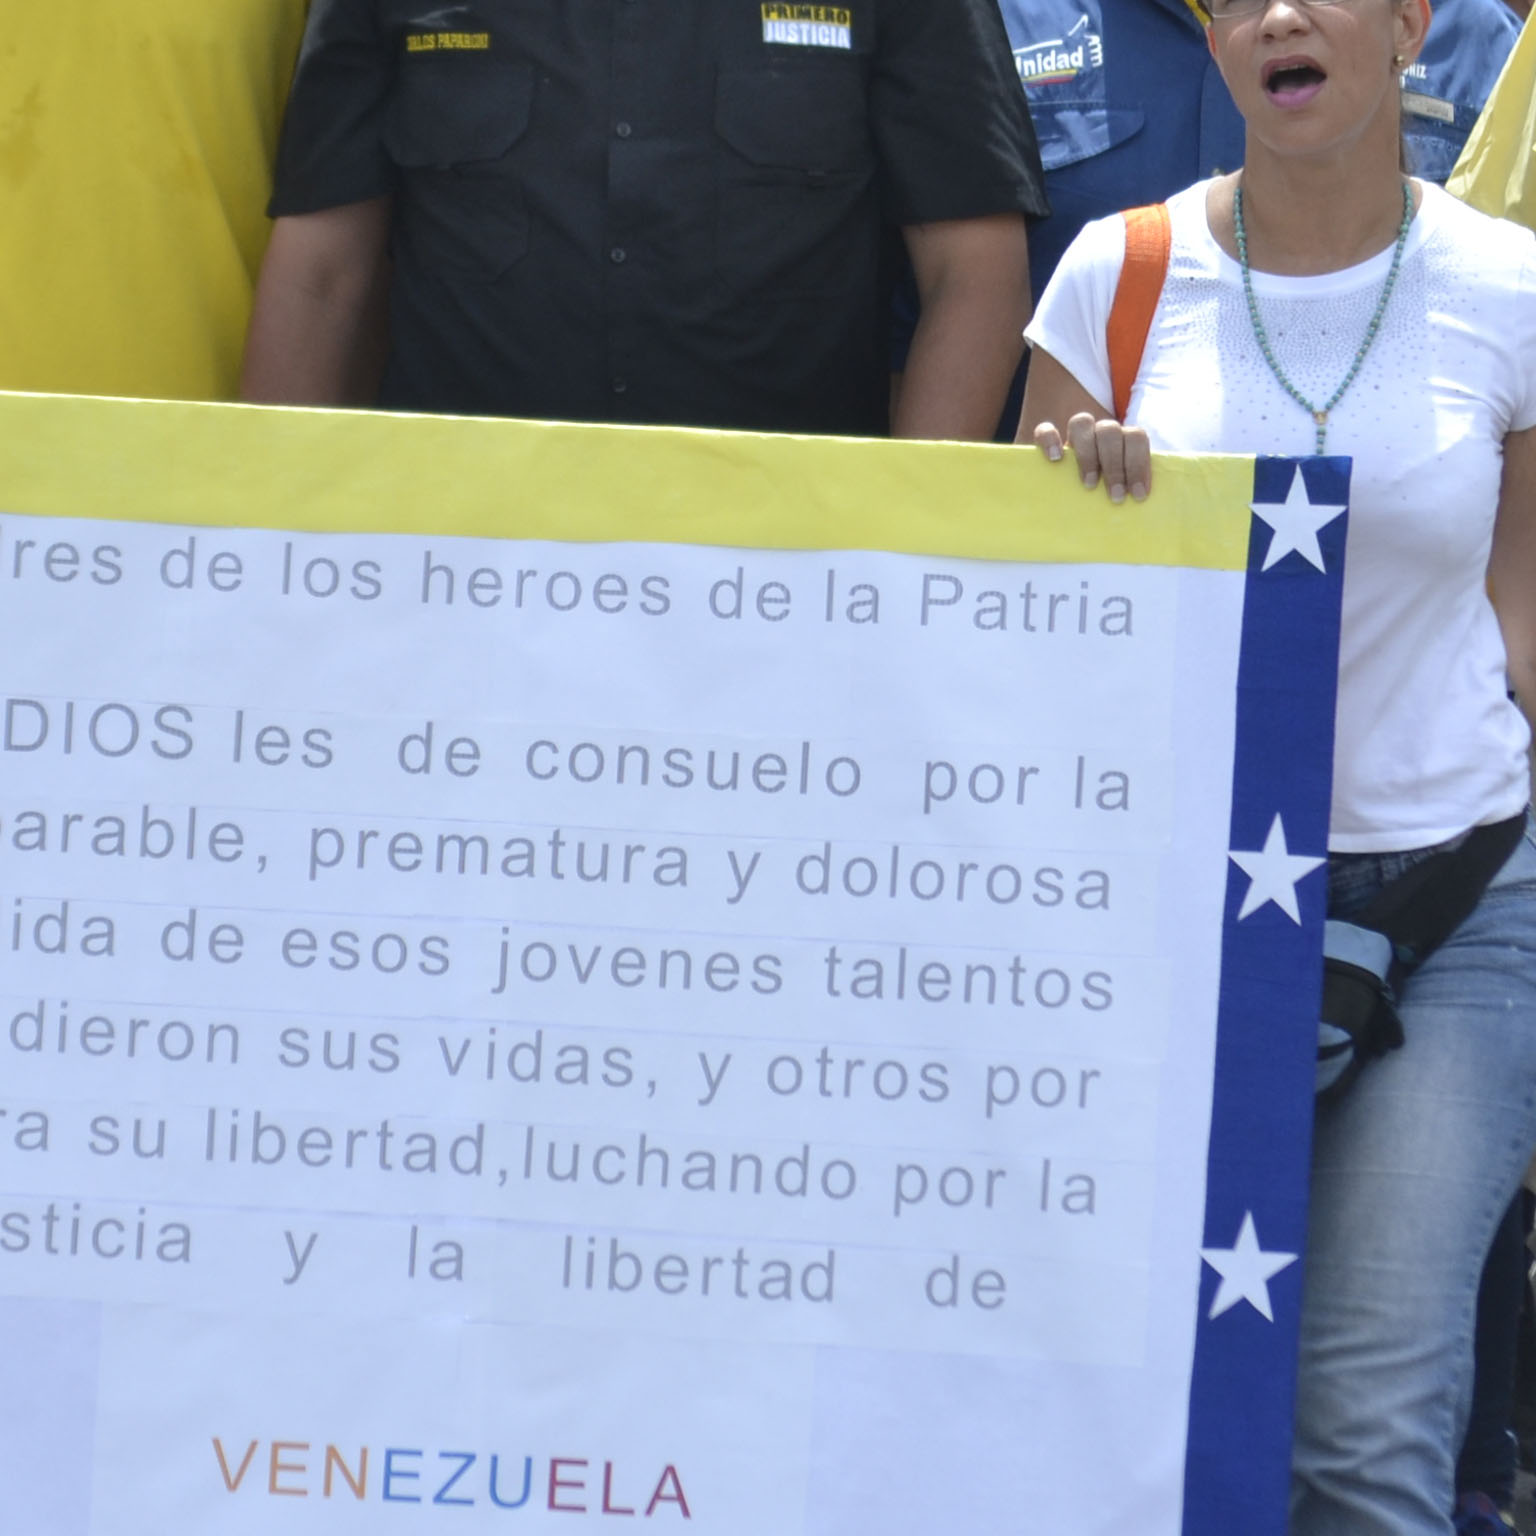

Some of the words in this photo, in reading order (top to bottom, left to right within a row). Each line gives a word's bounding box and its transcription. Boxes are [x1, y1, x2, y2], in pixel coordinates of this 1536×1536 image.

[764, 3, 848, 25] PRIMERO
[765, 22, 851, 49] JUSTICIA
[160, 537, 243, 592] de
[283, 542, 381, 600] los
[422, 551, 670, 616] heroes
[709, 567, 791, 622] de
[826, 569, 879, 624] la
[921, 574, 1132, 636] Patria
[4, 699, 193, 760] DIOS
[233, 710, 333, 768] les
[398, 721, 480, 777] de
[526, 740, 861, 797] consuelo
[923, 761, 1040, 815] por
[1075, 755, 1129, 811] la
[309, 828, 687, 887] prematura
[727, 851, 761, 904] y
[796, 841, 1109, 910] dolorosa
[161, 908, 244, 964] de
[282, 928, 449, 976] esos
[491, 927, 782, 994] jovenes
[824, 946, 1112, 1011] talentos
[10, 999, 239, 1064] dieron
[278, 1028, 400, 1073] sus
[438, 1027, 656, 1098] vidas,
[698, 1052, 732, 1106] y
[767, 1046, 949, 1102] otros
[986, 1065, 1101, 1119] por
[88, 1116, 165, 1158] su
[894, 1164, 1006, 1217] por
[1040, 1158, 1095, 1214] la
[283, 1231, 318, 1285] y
[408, 1225, 463, 1281] la
[563, 1235, 835, 1302] libertad
[925, 1254, 1006, 1310] de
[212, 1438, 691, 1520] VENEZUELA
